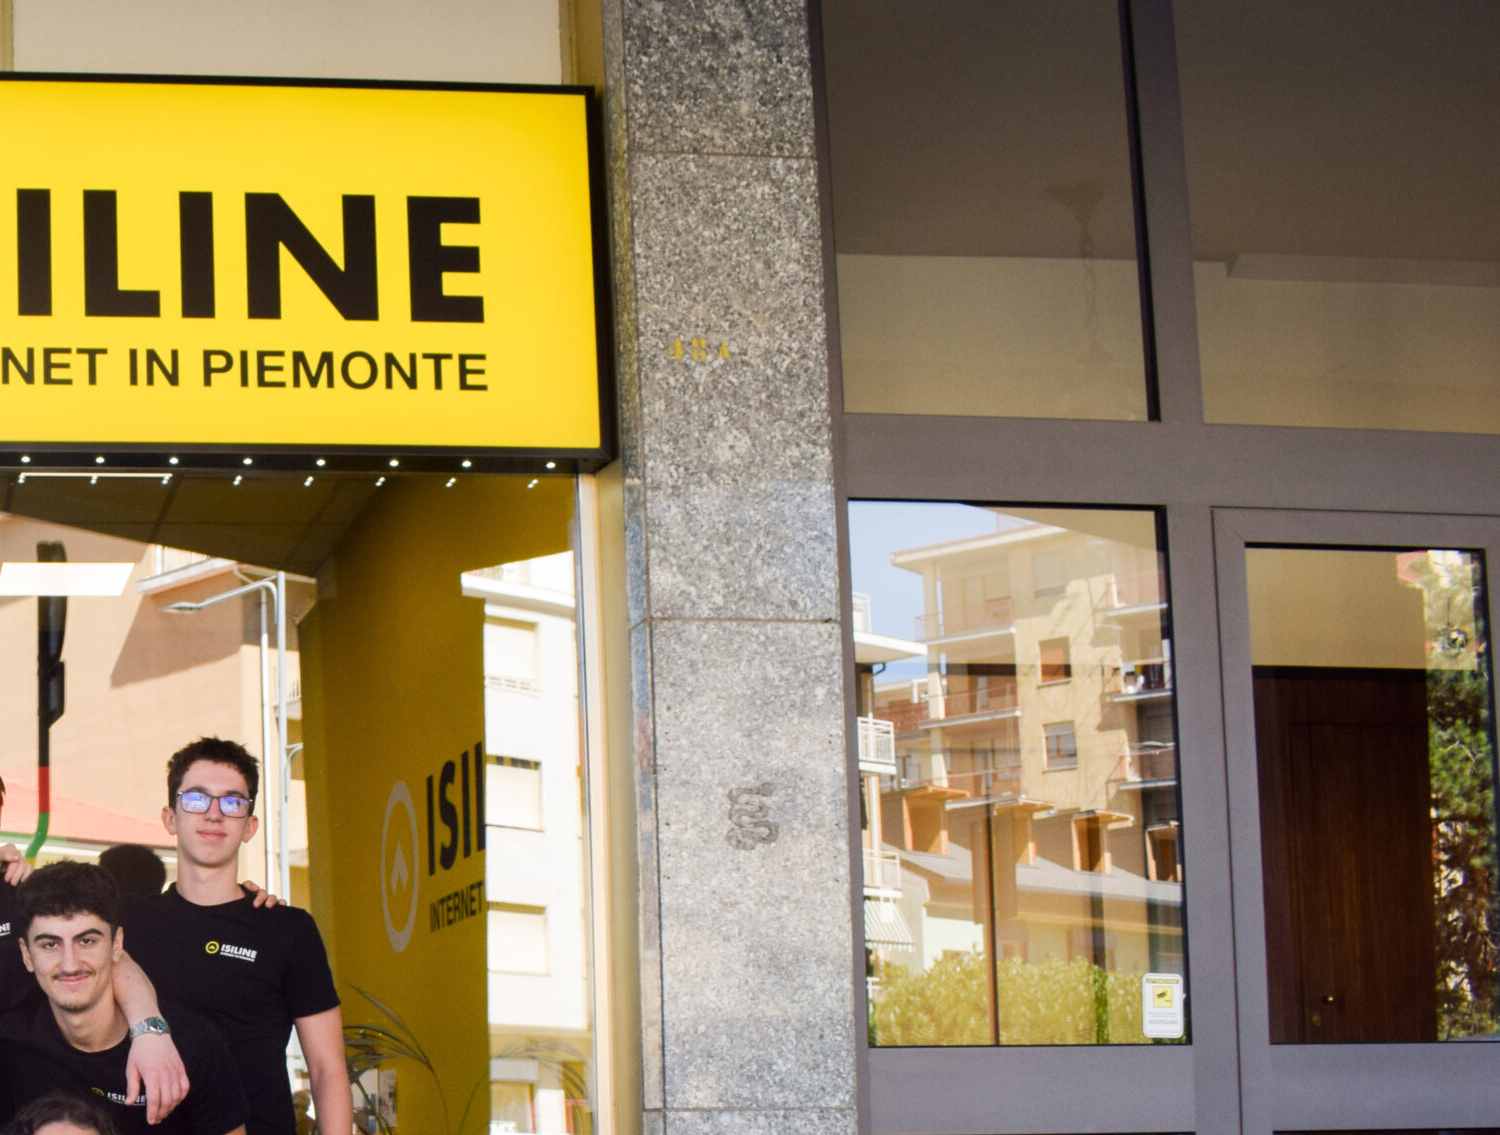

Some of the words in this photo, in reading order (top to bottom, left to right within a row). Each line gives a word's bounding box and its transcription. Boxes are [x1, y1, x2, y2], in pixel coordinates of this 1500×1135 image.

[129, 348, 180, 387] IN
[202, 349, 489, 392] PIEMONTE
[429, 881, 484, 934] INTERNET
[220, 943, 258, 960] ISILINE
